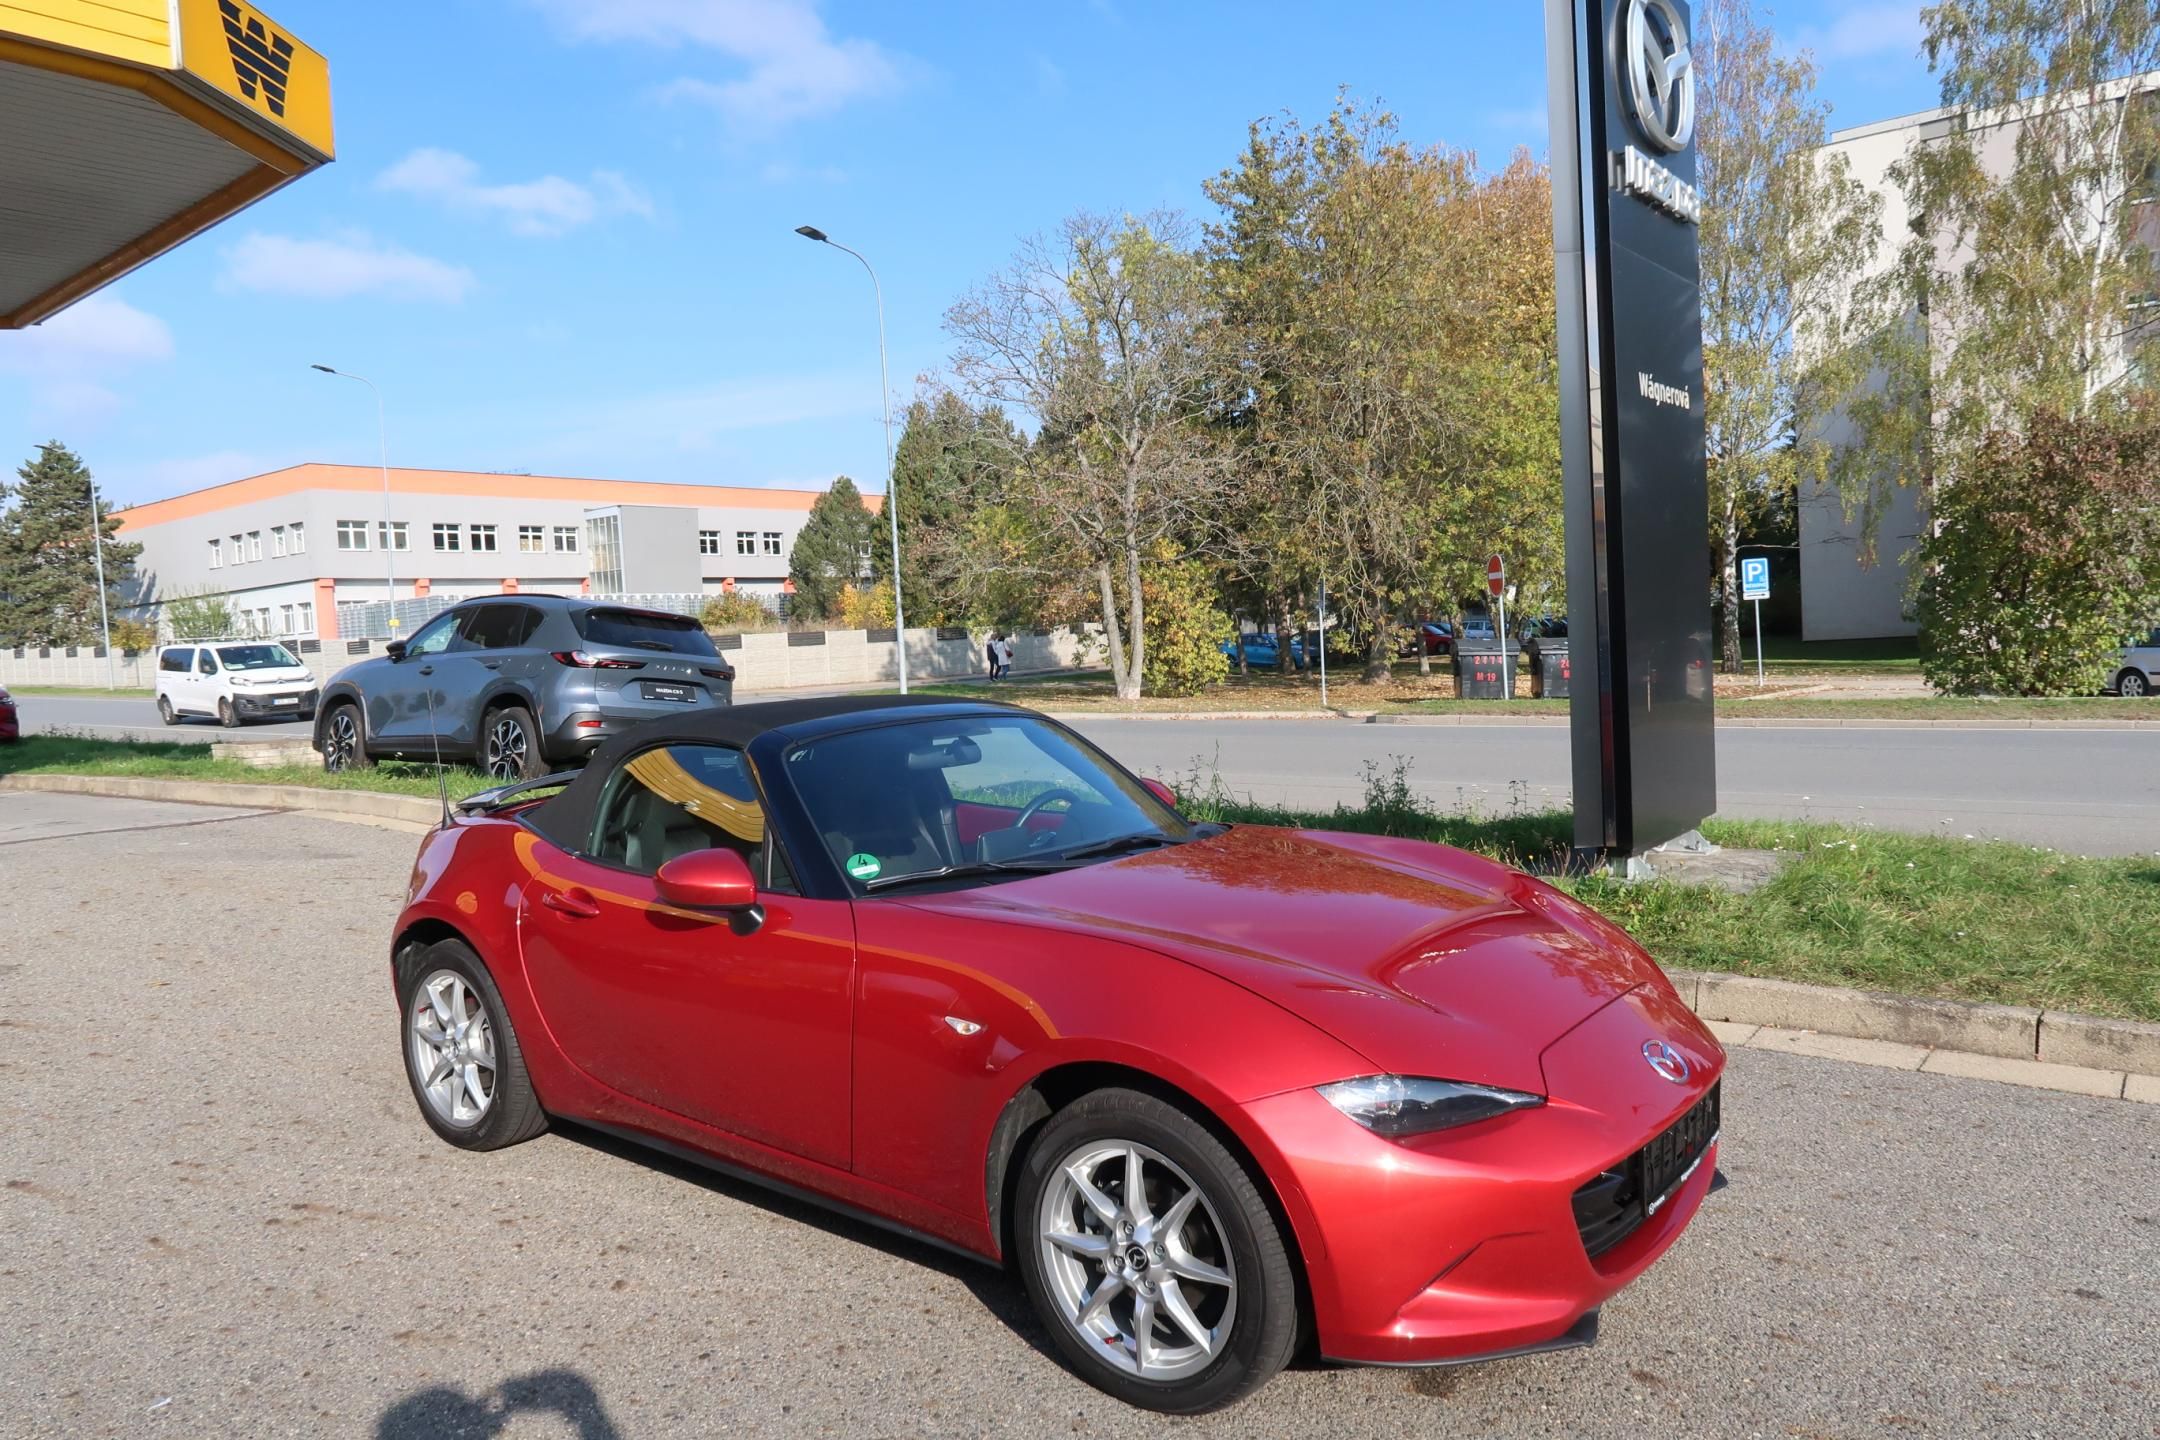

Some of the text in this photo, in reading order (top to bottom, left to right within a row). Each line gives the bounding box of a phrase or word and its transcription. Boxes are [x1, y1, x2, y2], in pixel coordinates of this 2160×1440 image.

[1638, 371, 1690, 409] Wágnerová
[1748, 563, 1762, 581] P
[858, 854, 868, 866] 4
